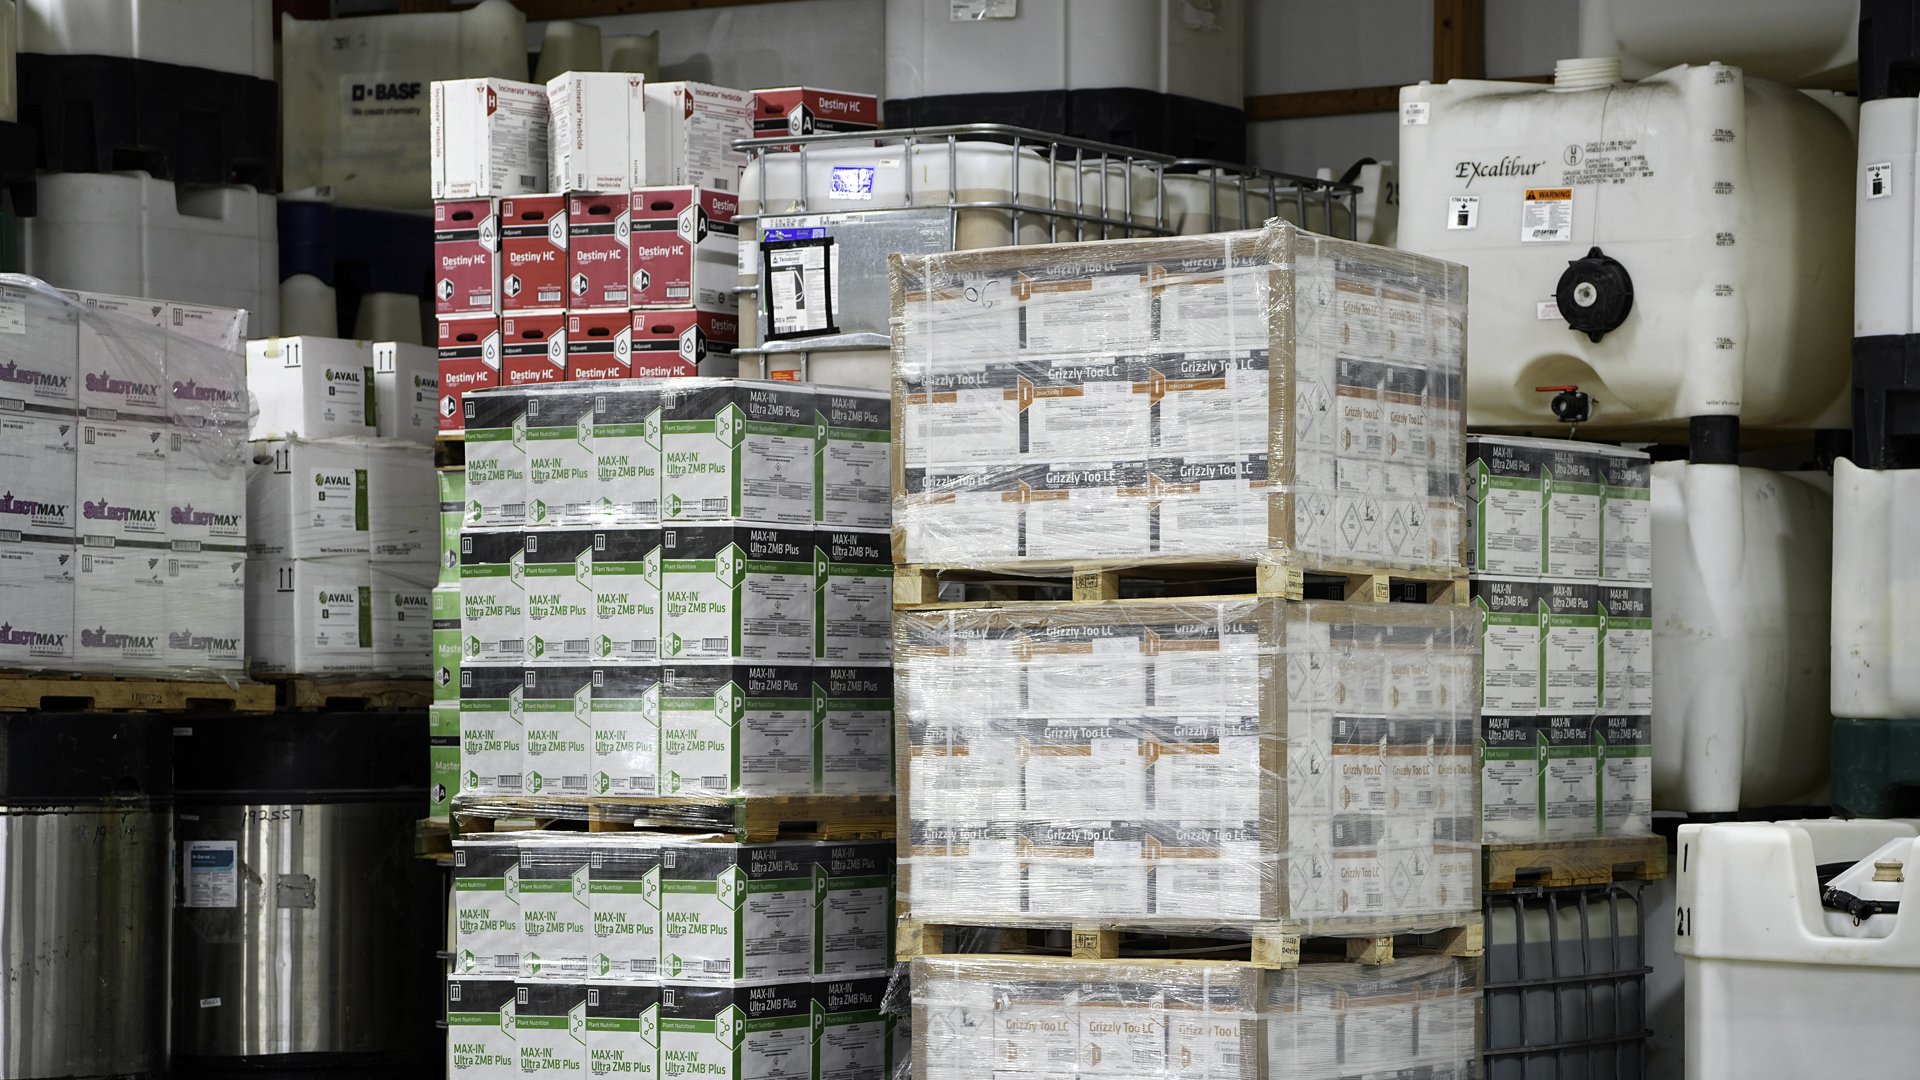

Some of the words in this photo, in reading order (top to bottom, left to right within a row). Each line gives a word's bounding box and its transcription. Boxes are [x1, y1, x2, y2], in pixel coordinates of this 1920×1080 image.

[376, 83, 421, 100] BASF
[721, 92, 742, 102] Herbicide
[489, 95, 495, 107] H
[686, 99, 692, 110] H
[850, 102, 860, 112] HC
[386, 108, 421, 116] chemistry
[804, 116, 812, 130] A
[543, 251, 555, 261] HC
[672, 245, 684, 255] HC
[474, 254, 485, 264] HC
[673, 366, 685, 376] HC
[1181, 361, 1216, 374] Grizzly
[1241, 359, 1254, 370] LC
[335, 371, 360, 382] AVAIL
[477, 372, 488, 381] HC
[1048, 368, 1082, 380] Grizzly
[750, 404, 767, 415] Ultra
[768, 405, 784, 416] ZMB
[785, 406, 800, 417] Plus
[1344, 406, 1362, 420] Grizzly
[1373, 410, 1379, 420] LC
[469, 470, 487, 481] Ultra
[488, 470, 505, 480] ZMB
[507, 469, 523, 480] Plus
[1180, 465, 1216, 478] Grizzly
[1239, 463, 1253, 474] LC
[325, 476, 351, 486] AVAIL
[750, 542, 767, 553] Ultra
[768, 543, 784, 554] ZMB
[785, 544, 799, 555] Plus
[328, 593, 354, 603] AVAIL
[404, 596, 428, 606] AVAIL
[1491, 595, 1503, 606] Ultra
[1504, 595, 1516, 606] ZMB
[1517, 596, 1529, 607] Plus
[597, 605, 616, 615] Ultra
[617, 605, 635, 614] ZMB
[638, 604, 654, 614] Plus
[749, 679, 766, 691] Ultra
[767, 680, 782, 691] ZMB
[784, 680, 798, 691] Plus
[734, 697, 742, 712] P
[1044, 726, 1078, 740] Grizzly
[1080, 727, 1099, 739] Too
[1100, 726, 1113, 738] LC
[1489, 729, 1502, 740] Ultra
[1502, 729, 1514, 740] ZMB
[1516, 730, 1527, 740] Plus
[666, 740, 685, 751] Ultra
[687, 741, 706, 751] ZMB
[708, 740, 725, 751] Plus
[1343, 764, 1361, 777] Grizzly
[1362, 765, 1372, 775] Too
[1373, 765, 1382, 775] LC
[242, 809, 304, 827] 192557
[460, 920, 479, 931] Ultra
[480, 921, 498, 931] ZMB
[500, 921, 516, 931] Plus
[1677, 906, 1691, 937] 21
[1006, 1018, 1038, 1033] Grizzly
[1040, 1020, 1057, 1031] Too
[1058, 1020, 1069, 1032] LC
[1089, 1020, 1122, 1035] Grizzly
[1142, 1022, 1154, 1034] LC
[521, 1059, 541, 1069] Ultra
[542, 1059, 561, 1069] ZMB
[563, 1059, 580, 1070] Plus
[665, 1062, 685, 1073] Ultra
[687, 1063, 706, 1074] ZMB
[708, 1064, 726, 1075] Plus
